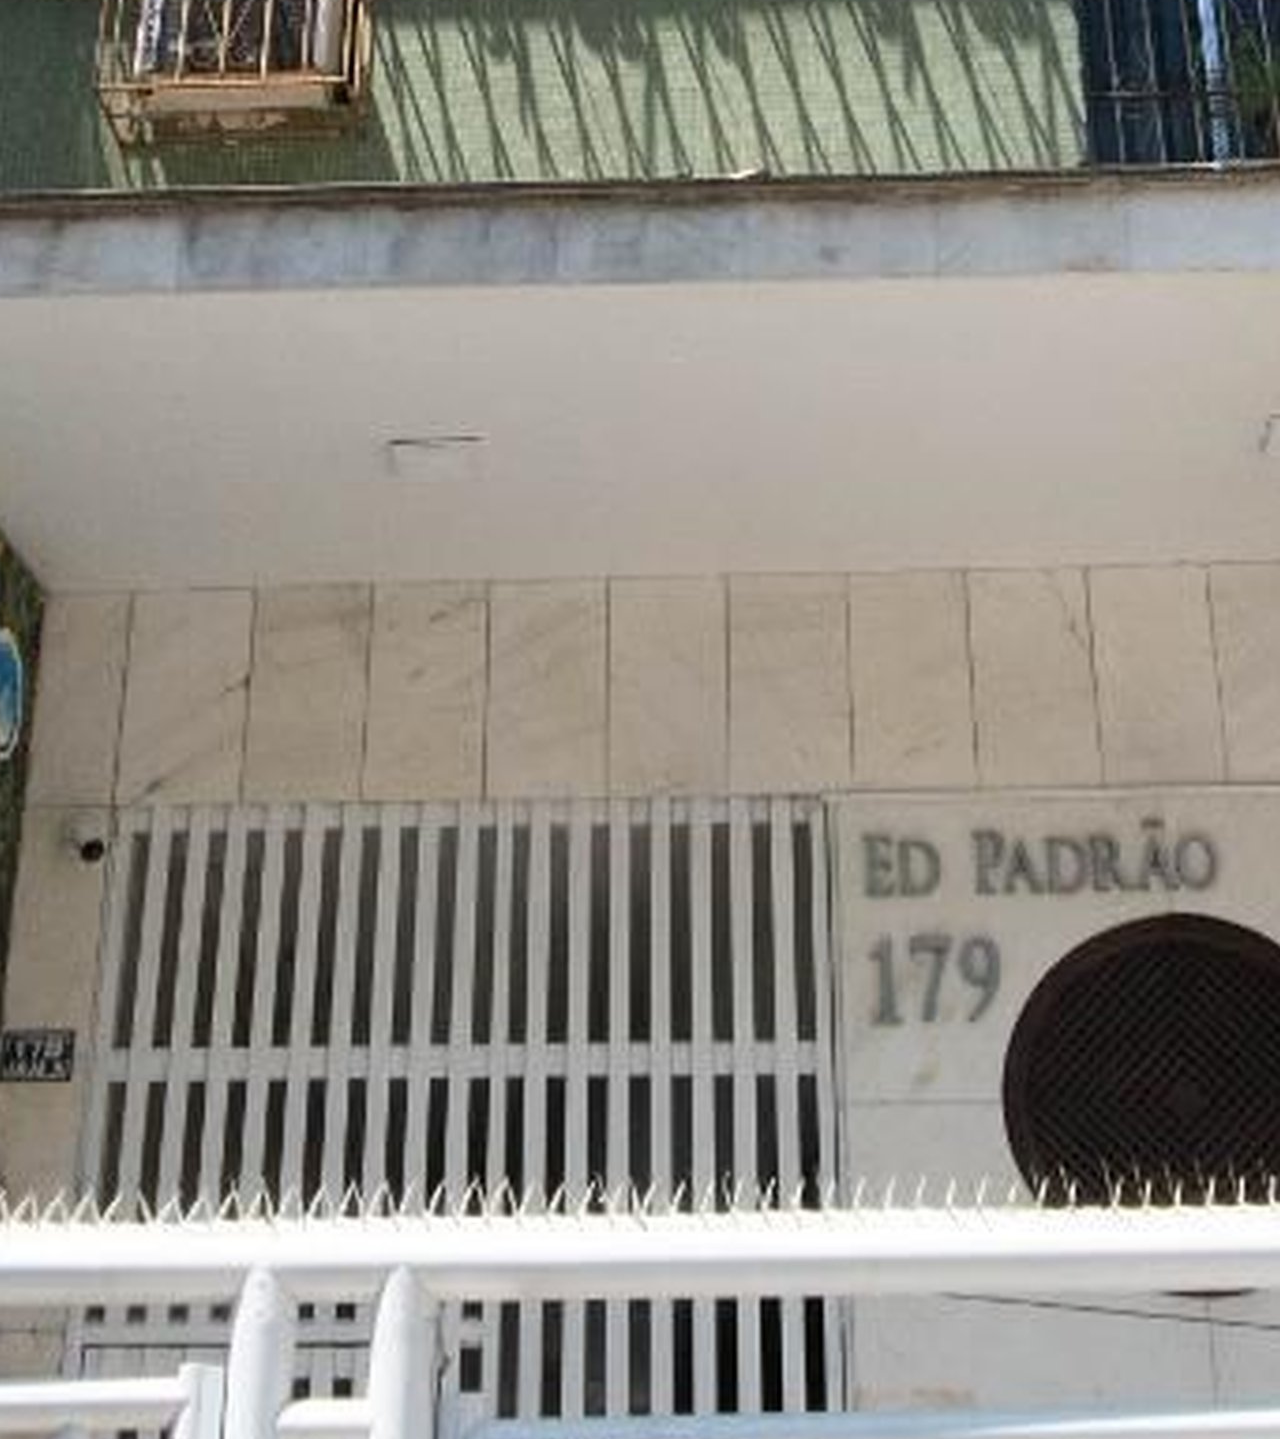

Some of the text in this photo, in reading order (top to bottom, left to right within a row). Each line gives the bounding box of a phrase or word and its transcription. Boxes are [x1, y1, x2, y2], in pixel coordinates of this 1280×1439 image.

[862, 817, 1218, 899] ED PADRÃO
[868, 933, 1004, 1027] 179
